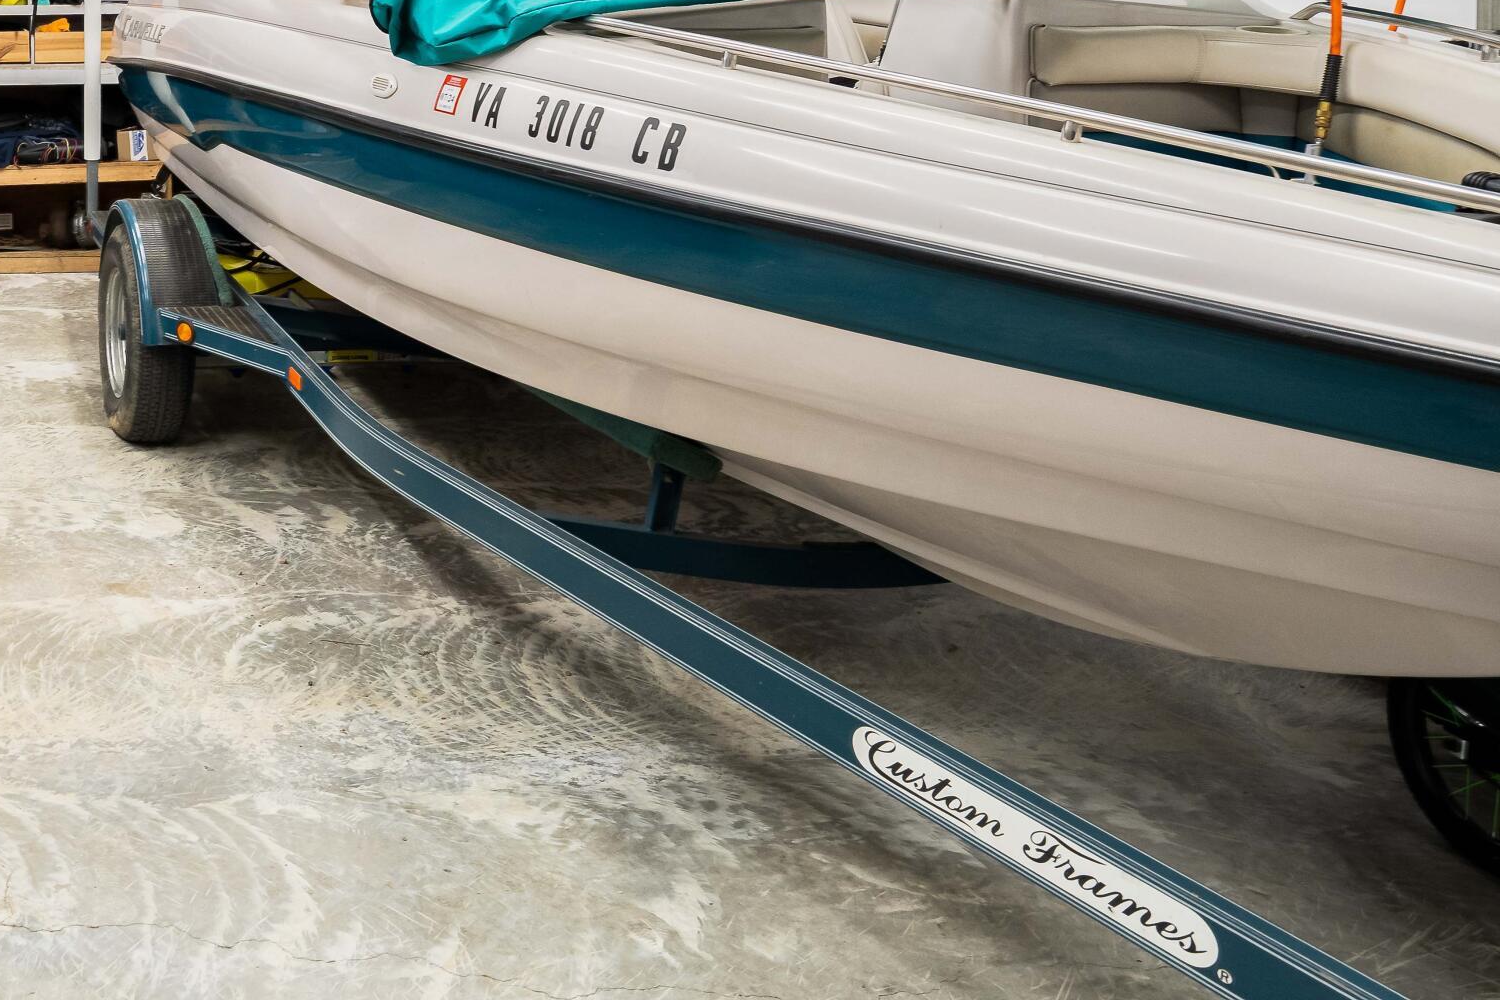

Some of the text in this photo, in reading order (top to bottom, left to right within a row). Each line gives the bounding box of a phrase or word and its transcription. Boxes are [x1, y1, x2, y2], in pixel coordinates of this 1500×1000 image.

[471, 82, 687, 172] VA 3018 CB
[864, 729, 1209, 956] Custom Frames
